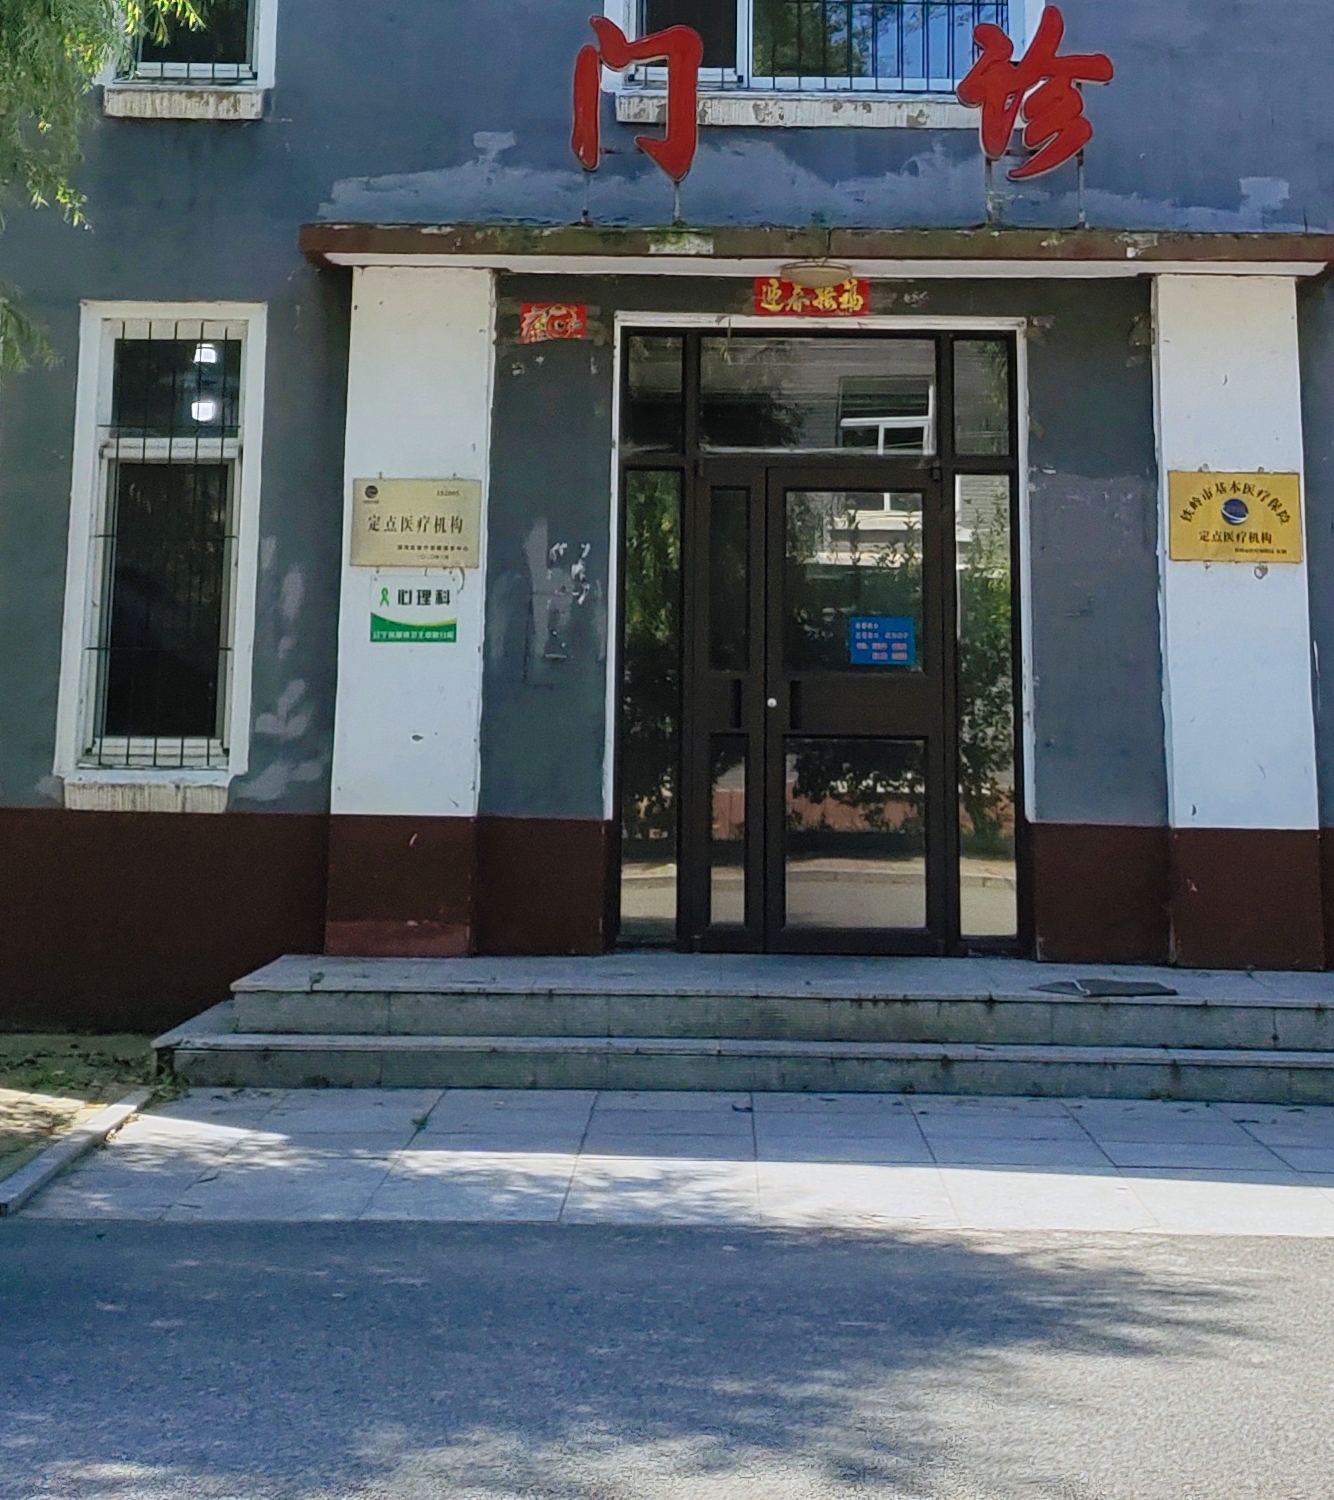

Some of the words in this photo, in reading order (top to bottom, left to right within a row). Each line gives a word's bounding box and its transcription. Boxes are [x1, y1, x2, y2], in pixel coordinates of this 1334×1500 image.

[1180, 481, 1291, 526] 铁岭市基本医疗保险
[368, 515, 464, 535] 定点医疗机构
[1198, 530, 1273, 545] 定点医疗机构
[397, 589, 451, 606] 心理科
